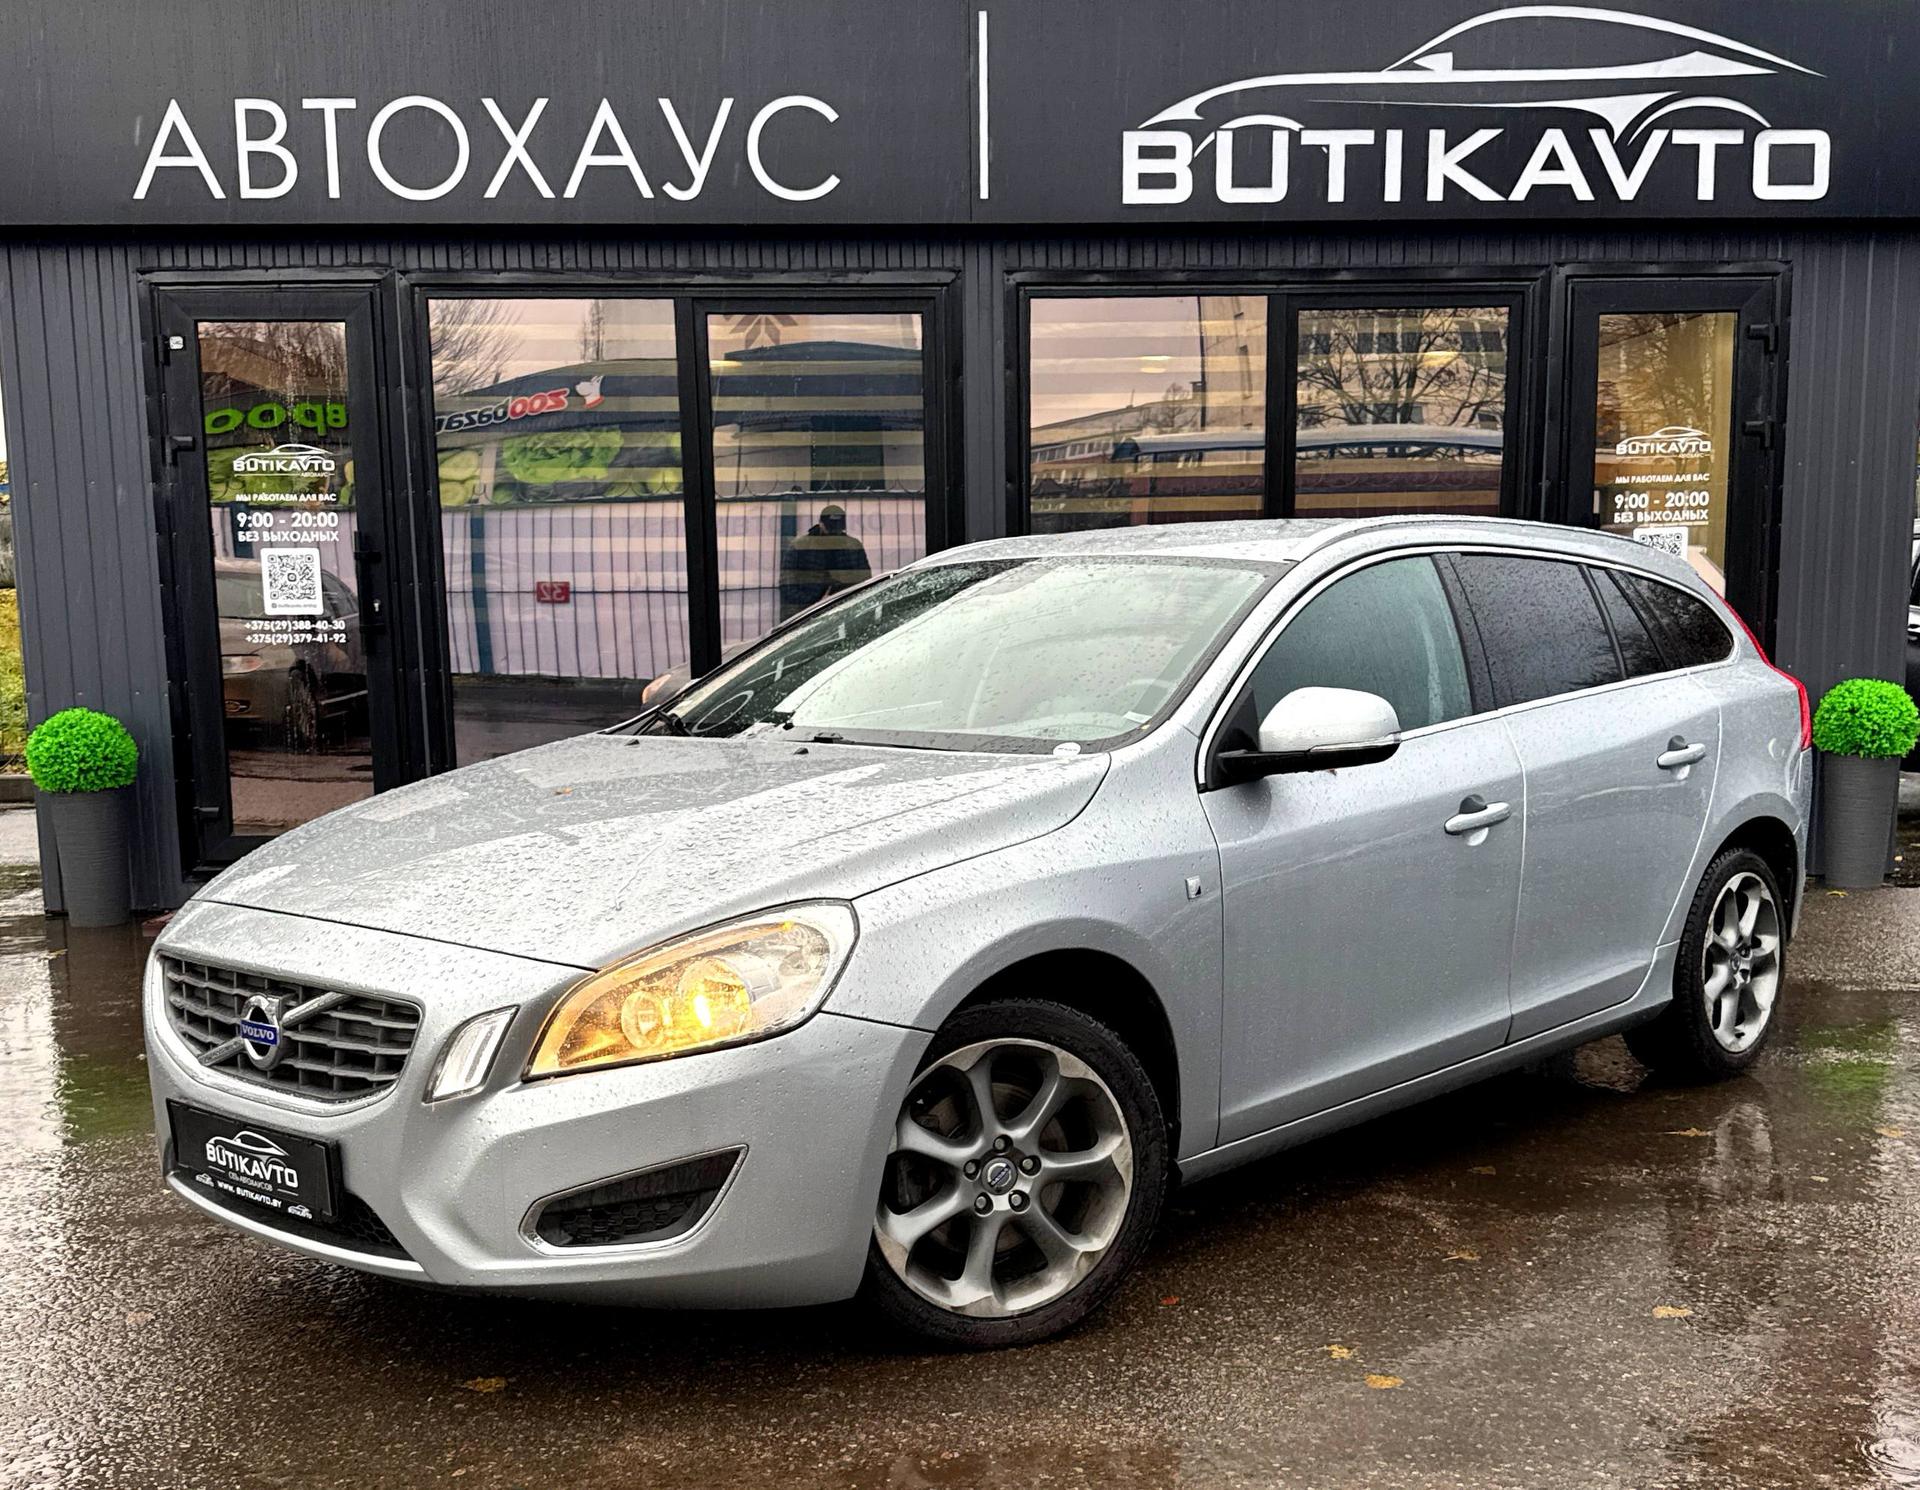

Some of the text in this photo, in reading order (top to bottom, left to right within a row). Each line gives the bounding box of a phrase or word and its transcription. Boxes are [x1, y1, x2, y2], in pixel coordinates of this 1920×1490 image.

[132, 95, 841, 201] АВТОХАУС
[1122, 127, 1831, 205] BUTIKAVTO
[1616, 441, 1711, 455] BUTIKAVTO
[233, 459, 335, 472] BUTIKAVTO
[1615, 473, 1710, 484] МЫ РАБОТАЕМ ДЛЯ ВАС
[236, 493, 337, 502] МЫ РАБОТАЕМ ДЛЯ ВАС
[1614, 493, 1649, 509] 9:00
[1665, 491, 1710, 507] 20:00
[236, 512, 274, 528] 9:00
[291, 511, 339, 528] 20:00
[1613, 509, 1709, 523] БЕЗ ВЫХОДНЫХ
[237, 530, 340, 543] БЕЗ ВЫХОДНЫХ
[245, 633, 347, 645] +375(29)379-41-92
[242, 1025, 275, 1040] VOLVO
[206, 1143, 298, 1188] BUTIKAVTO
